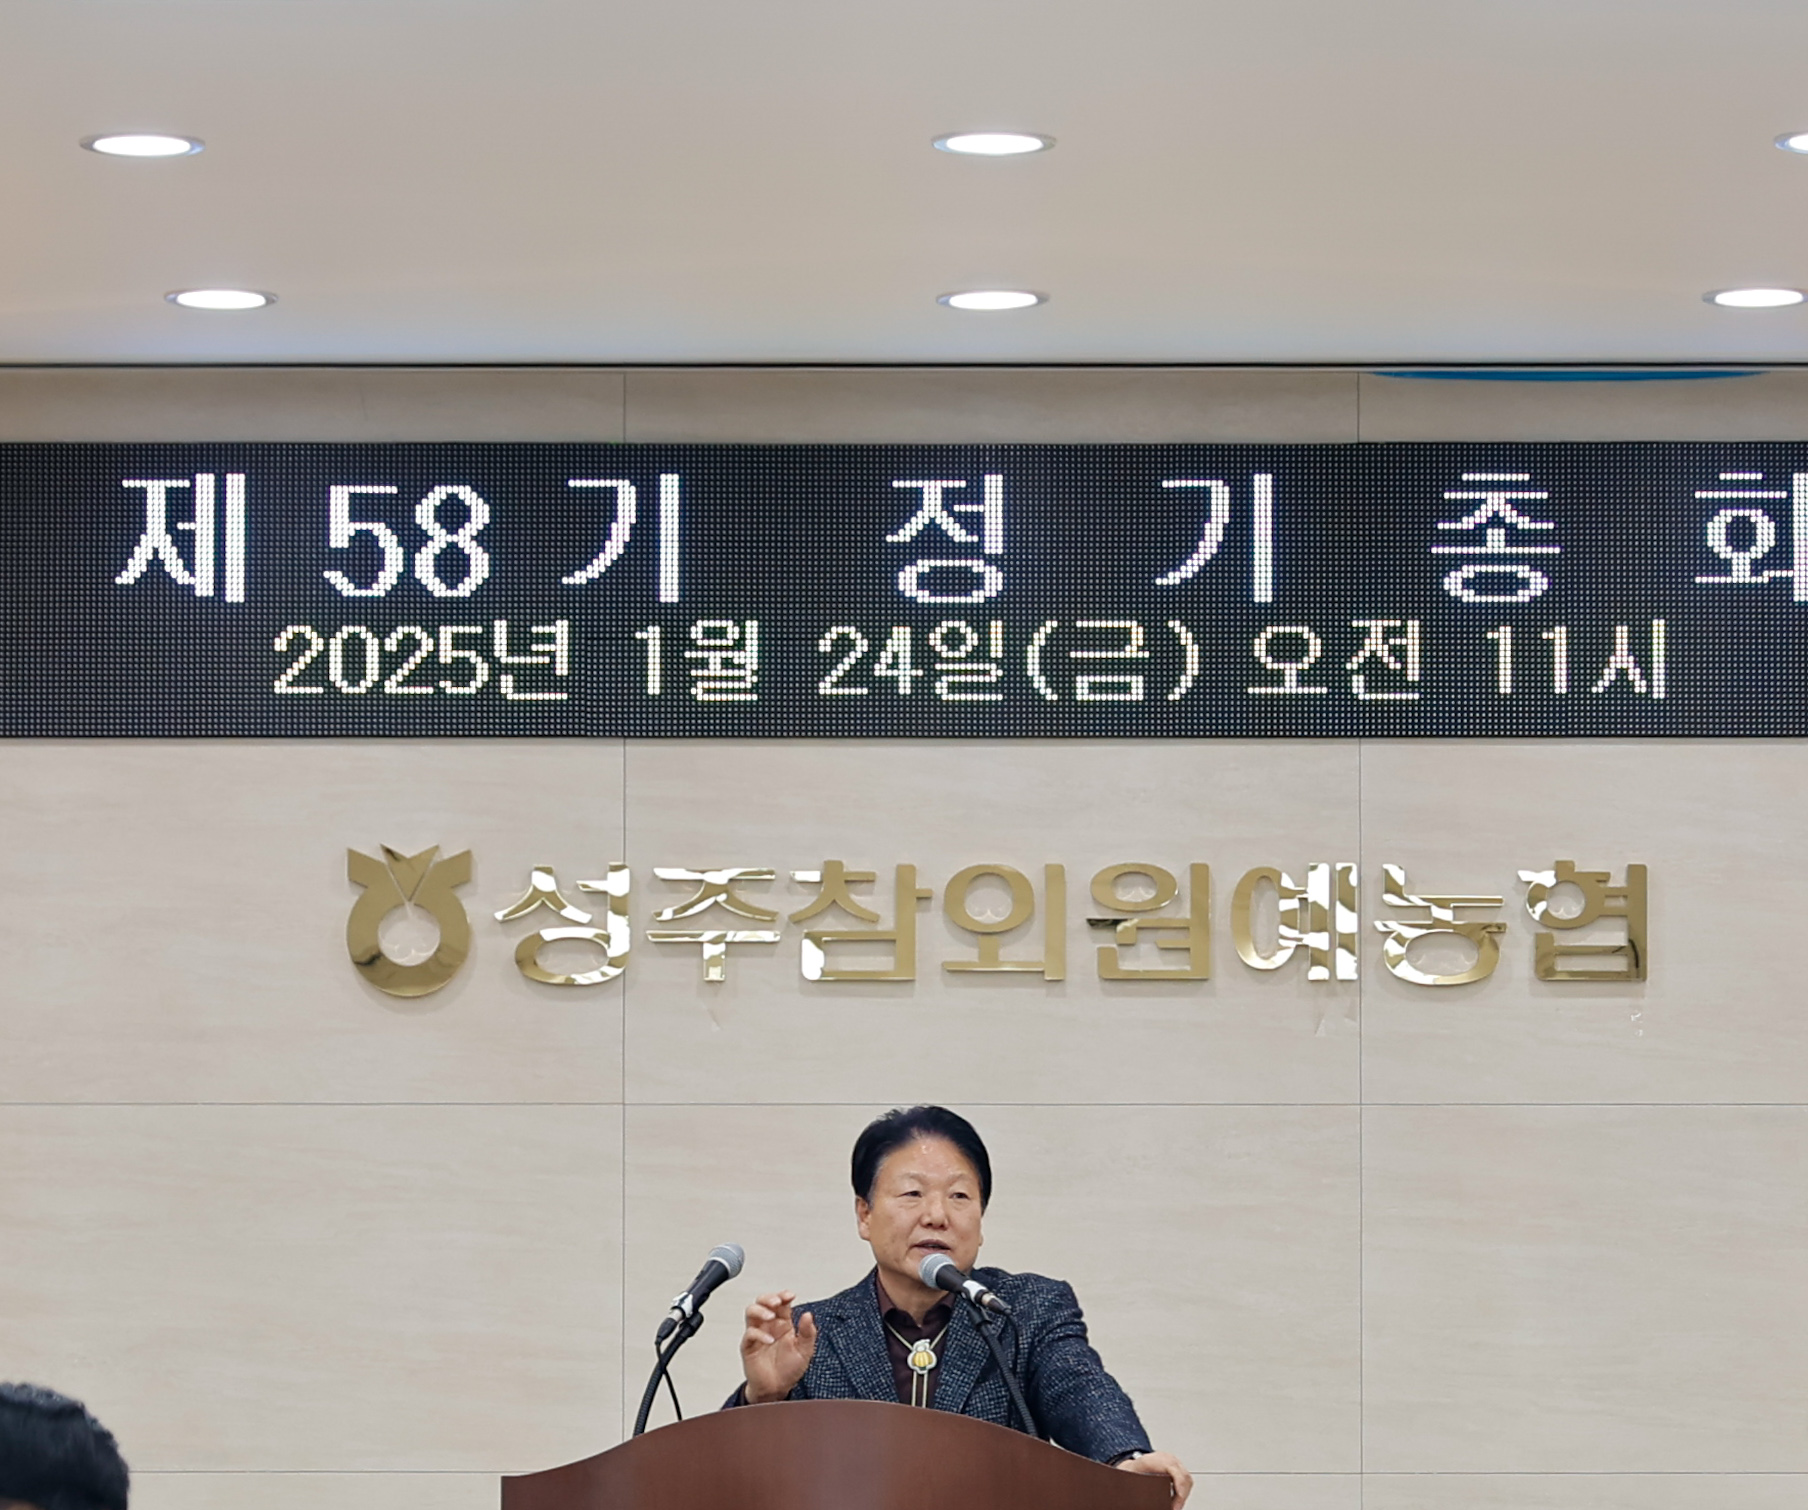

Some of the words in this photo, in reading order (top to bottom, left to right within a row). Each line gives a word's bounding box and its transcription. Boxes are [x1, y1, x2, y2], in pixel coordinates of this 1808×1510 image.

[114, 471, 247, 604] 제
[323, 484, 491, 599] 58
[561, 471, 681, 604] 기
[884, 472, 1005, 604] 정
[1154, 471, 1275, 604] 기
[1430, 471, 1563, 604] 총
[272, 617, 571, 702] 2025년
[634, 617, 761, 702] 1월
[816, 617, 1202, 702] 24일(금)
[1245, 617, 1424, 701] 오전
[1483, 617, 1669, 701] 11시
[494, 859, 1648, 986] 성주참외원예농협
